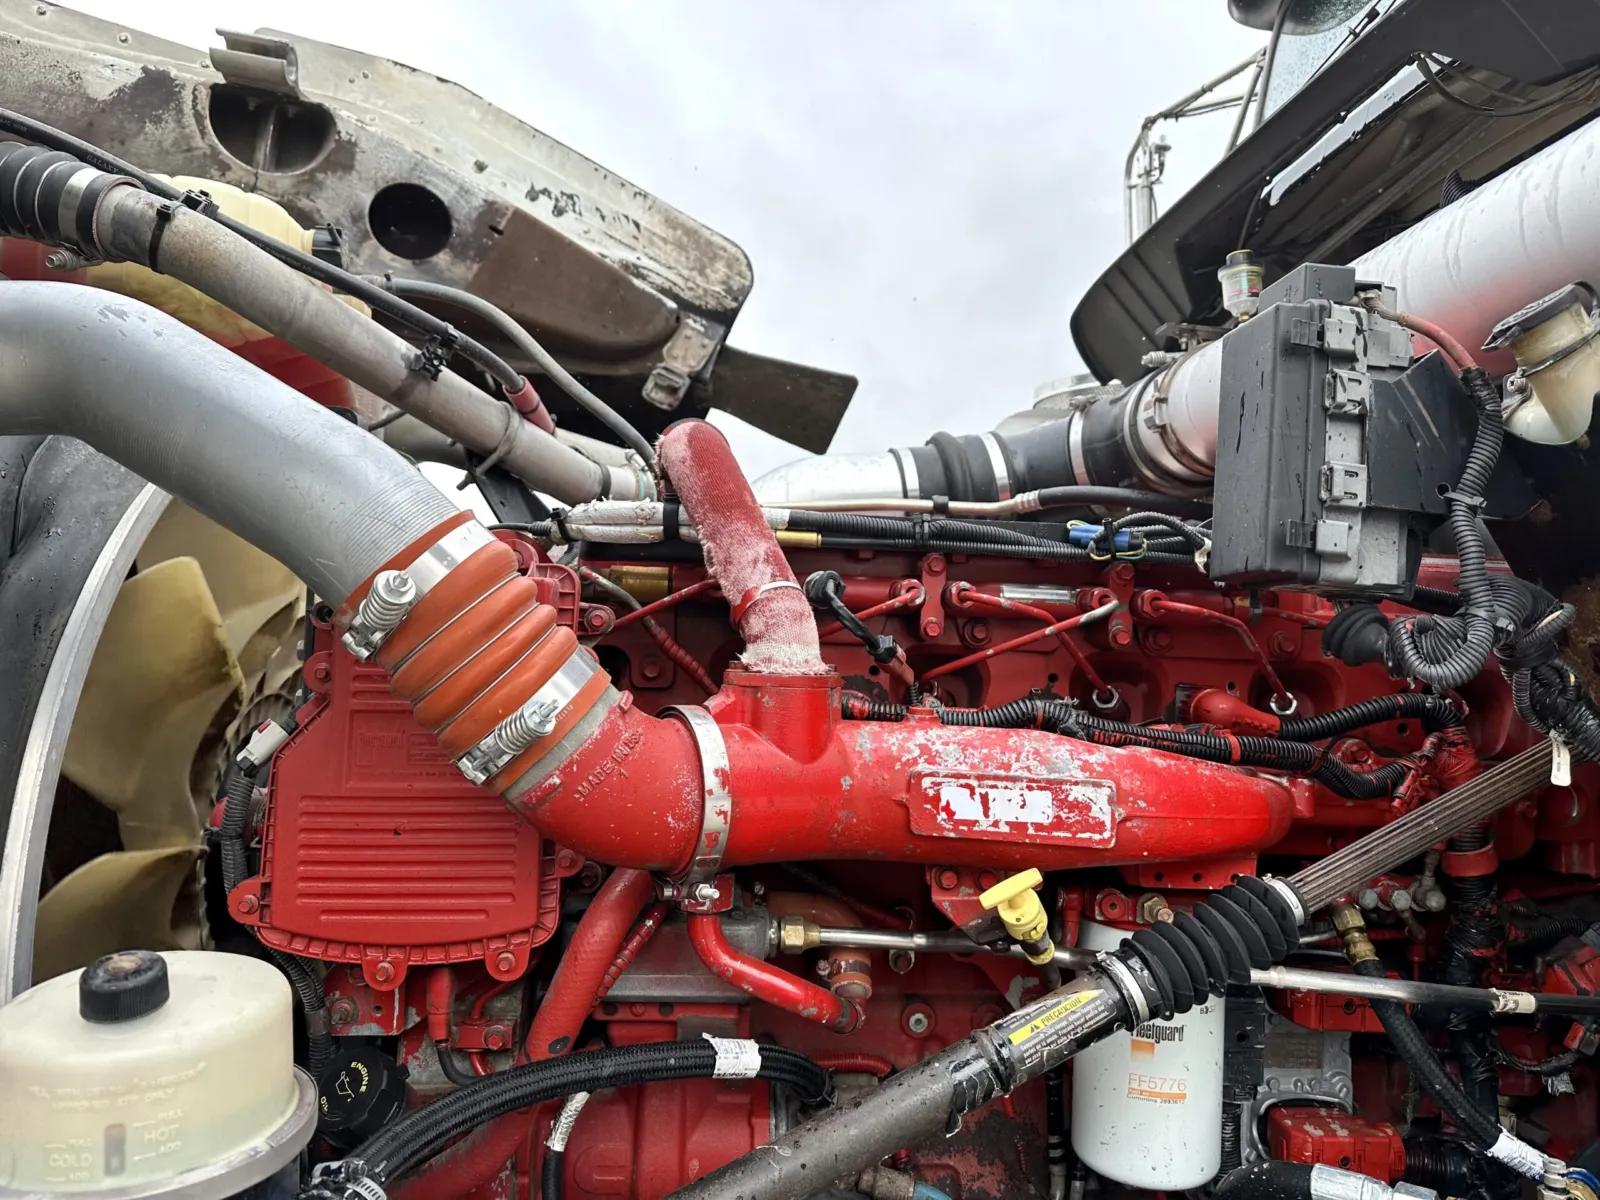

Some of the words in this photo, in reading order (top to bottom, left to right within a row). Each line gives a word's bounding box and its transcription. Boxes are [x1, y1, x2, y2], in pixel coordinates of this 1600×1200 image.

[576, 760, 615, 798] MADE
[1130, 1023, 1184, 1044] leetguard
[351, 1061, 368, 1093] ENGINE
[1128, 1072, 1186, 1091] FF5776
[320, 1096, 328, 1111] OIL
[144, 1124, 179, 1143] HOT
[49, 1153, 92, 1168] COLD
